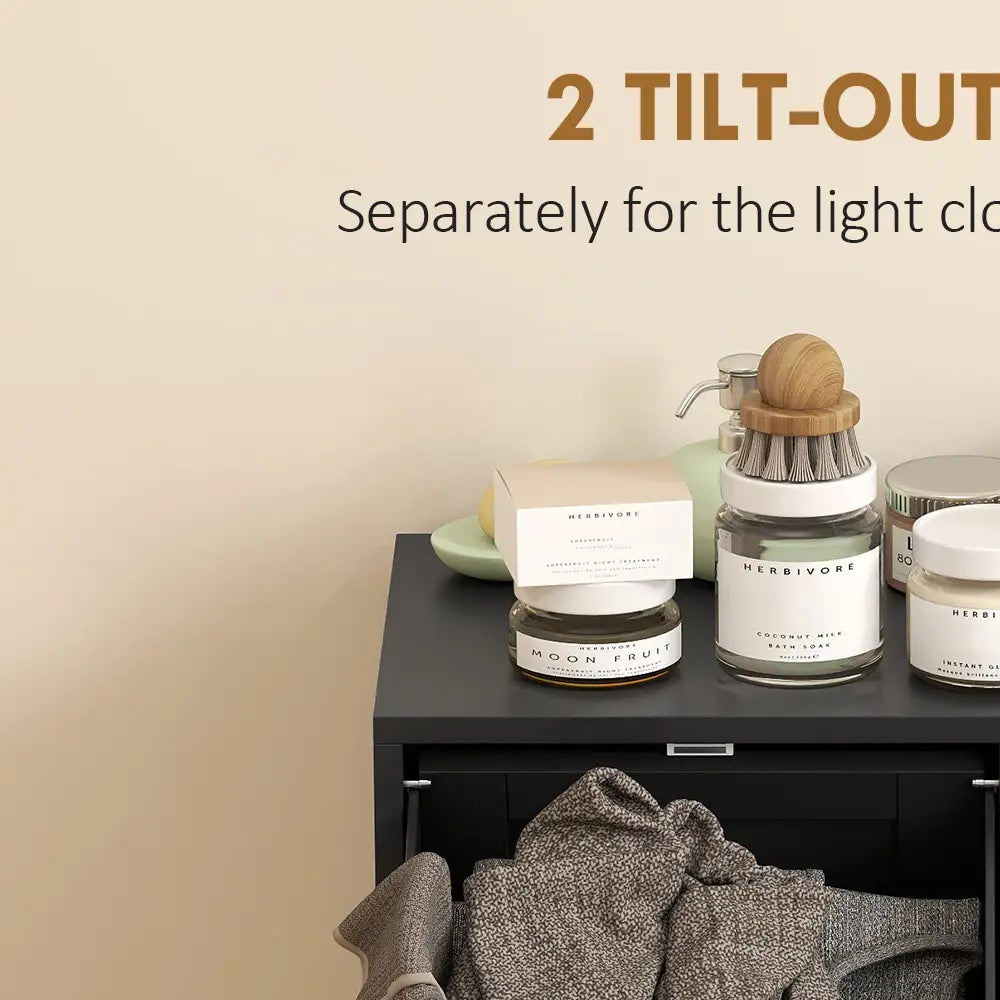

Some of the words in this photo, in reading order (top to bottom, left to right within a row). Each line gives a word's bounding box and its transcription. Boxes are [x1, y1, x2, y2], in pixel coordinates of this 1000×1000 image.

[568, 511, 640, 520] HERBIVORE
[743, 562, 855, 576] HERBIVORE
[756, 631, 811, 640] COCONUT
[817, 631, 842, 639] MILK
[579, 643, 637, 651] HERBIVORE
[531, 649, 597, 664] MOON
[614, 643, 672, 663] FRUIT
[942, 660, 984, 669] INSTANT
